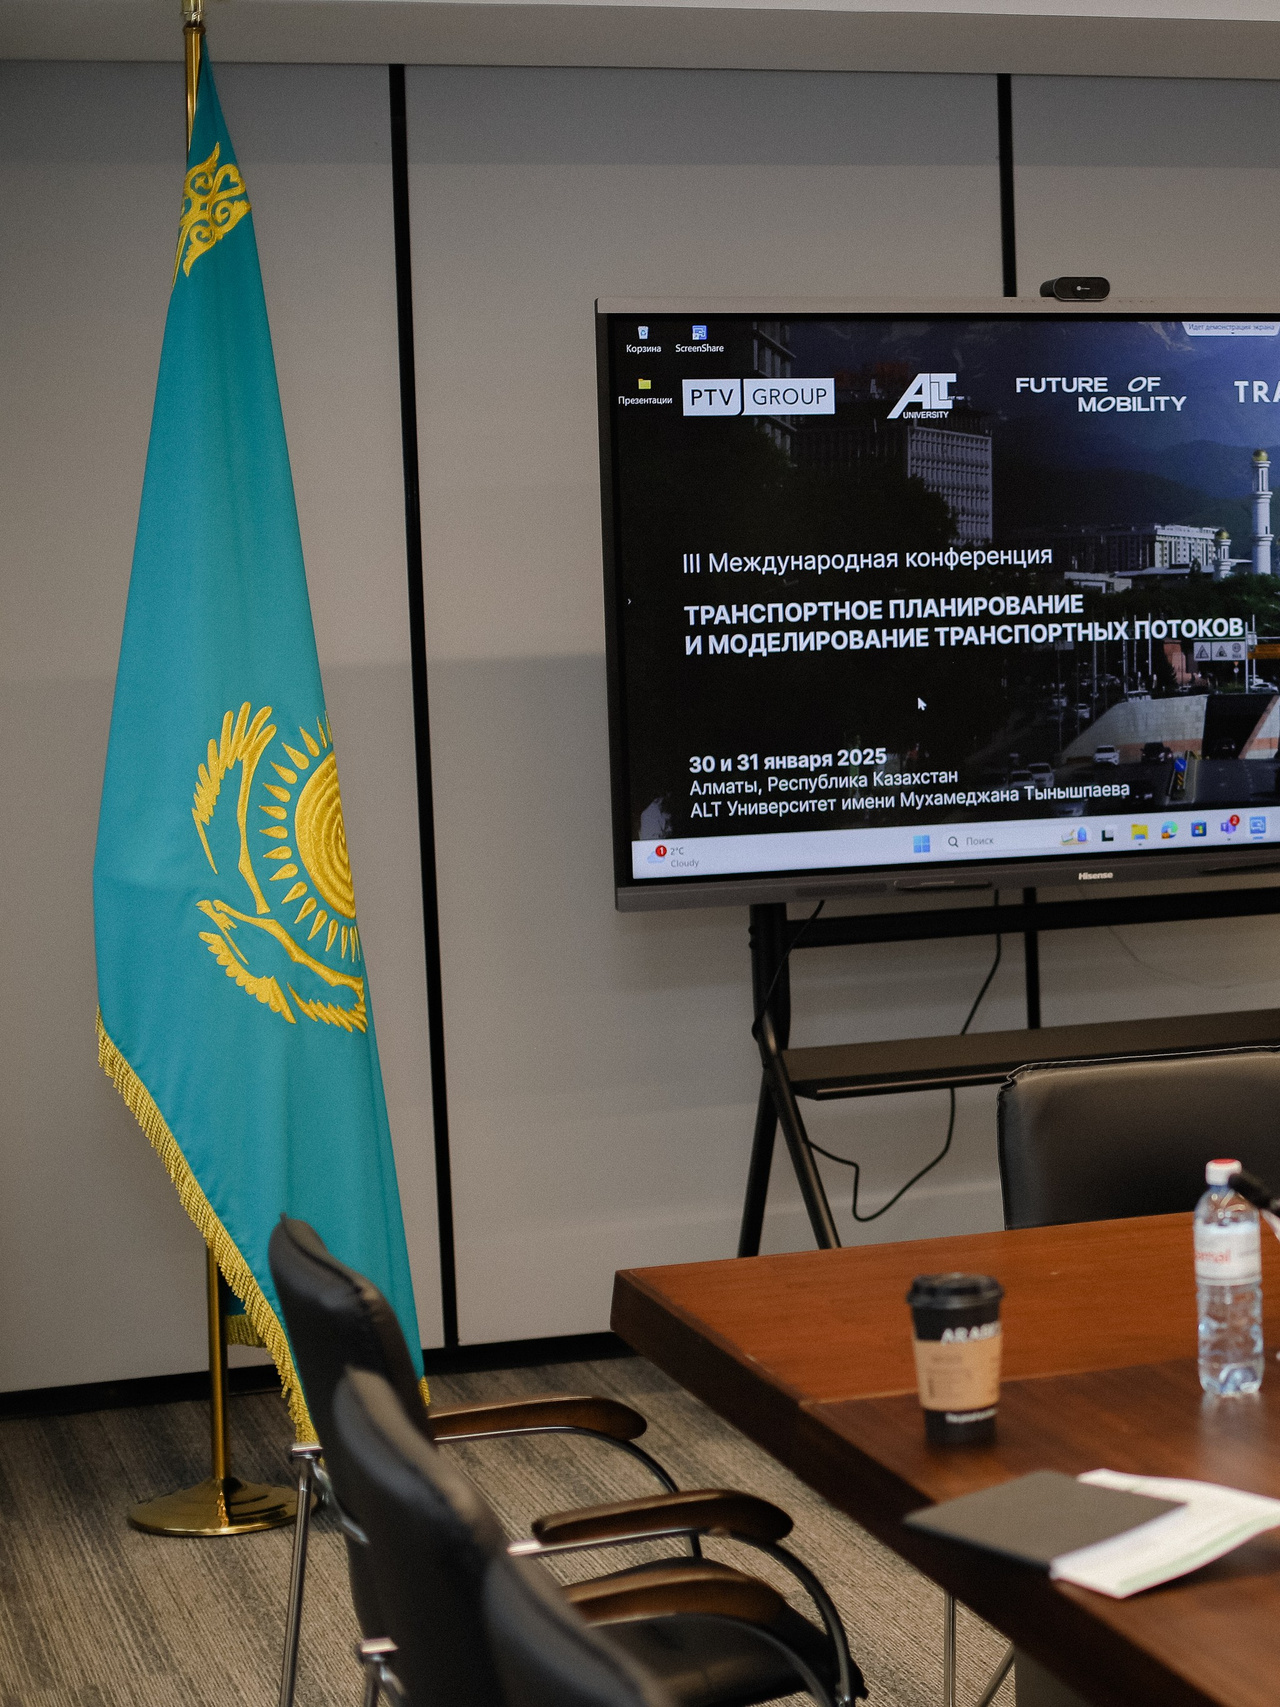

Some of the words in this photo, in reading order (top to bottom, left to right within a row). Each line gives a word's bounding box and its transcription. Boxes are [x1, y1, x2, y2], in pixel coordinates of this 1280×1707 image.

[626, 344, 662, 355] Корзина
[675, 343, 724, 353] ScreenShare
[1015, 377, 1108, 393] FUTURE
[1127, 376, 1162, 393] OF
[618, 396, 673, 406] Презентации
[690, 388, 735, 407] PTV
[752, 388, 827, 406] GROUP
[887, 373, 957, 419] ALT
[1077, 396, 1187, 412] MOBILITY
[902, 411, 949, 419] UNIVERSITY
[683, 553, 701, 574] III
[708, 550, 899, 575] Международная
[905, 547, 1053, 571] конференция
[684, 600, 882, 625] ТРАНСПОРТНОЕ
[888, 594, 1084, 619] ПЛАНИРОВАНИЕ
[685, 636, 702, 655] И
[708, 627, 929, 657] МОДЕЛИРОВАНИЕ
[934, 621, 1129, 647] ТРАНСПОРТНЫХ
[1134, 617, 1244, 641] ПОТОКОВ
[689, 755, 716, 774] 30
[720, 758, 733, 772] и
[736, 753, 759, 772] 31
[763, 754, 833, 773] января
[837, 748, 887, 766] 2025
[689, 778, 763, 797] Алматы,
[767, 772, 869, 795] Республика
[872, 768, 959, 788] Казахстан
[690, 801, 723, 819] ALT
[727, 795, 837, 819] Университет
[841, 796, 895, 811] имени
[899, 787, 1020, 808] Мухамеджана
[1024, 782, 1131, 802] Тынышпаева
[966, 836, 994, 847] Поиск
[670, 847, 684, 856] 2°C
[670, 858, 699, 869] Cloudy
[1078, 870, 1113, 880] Hisense
